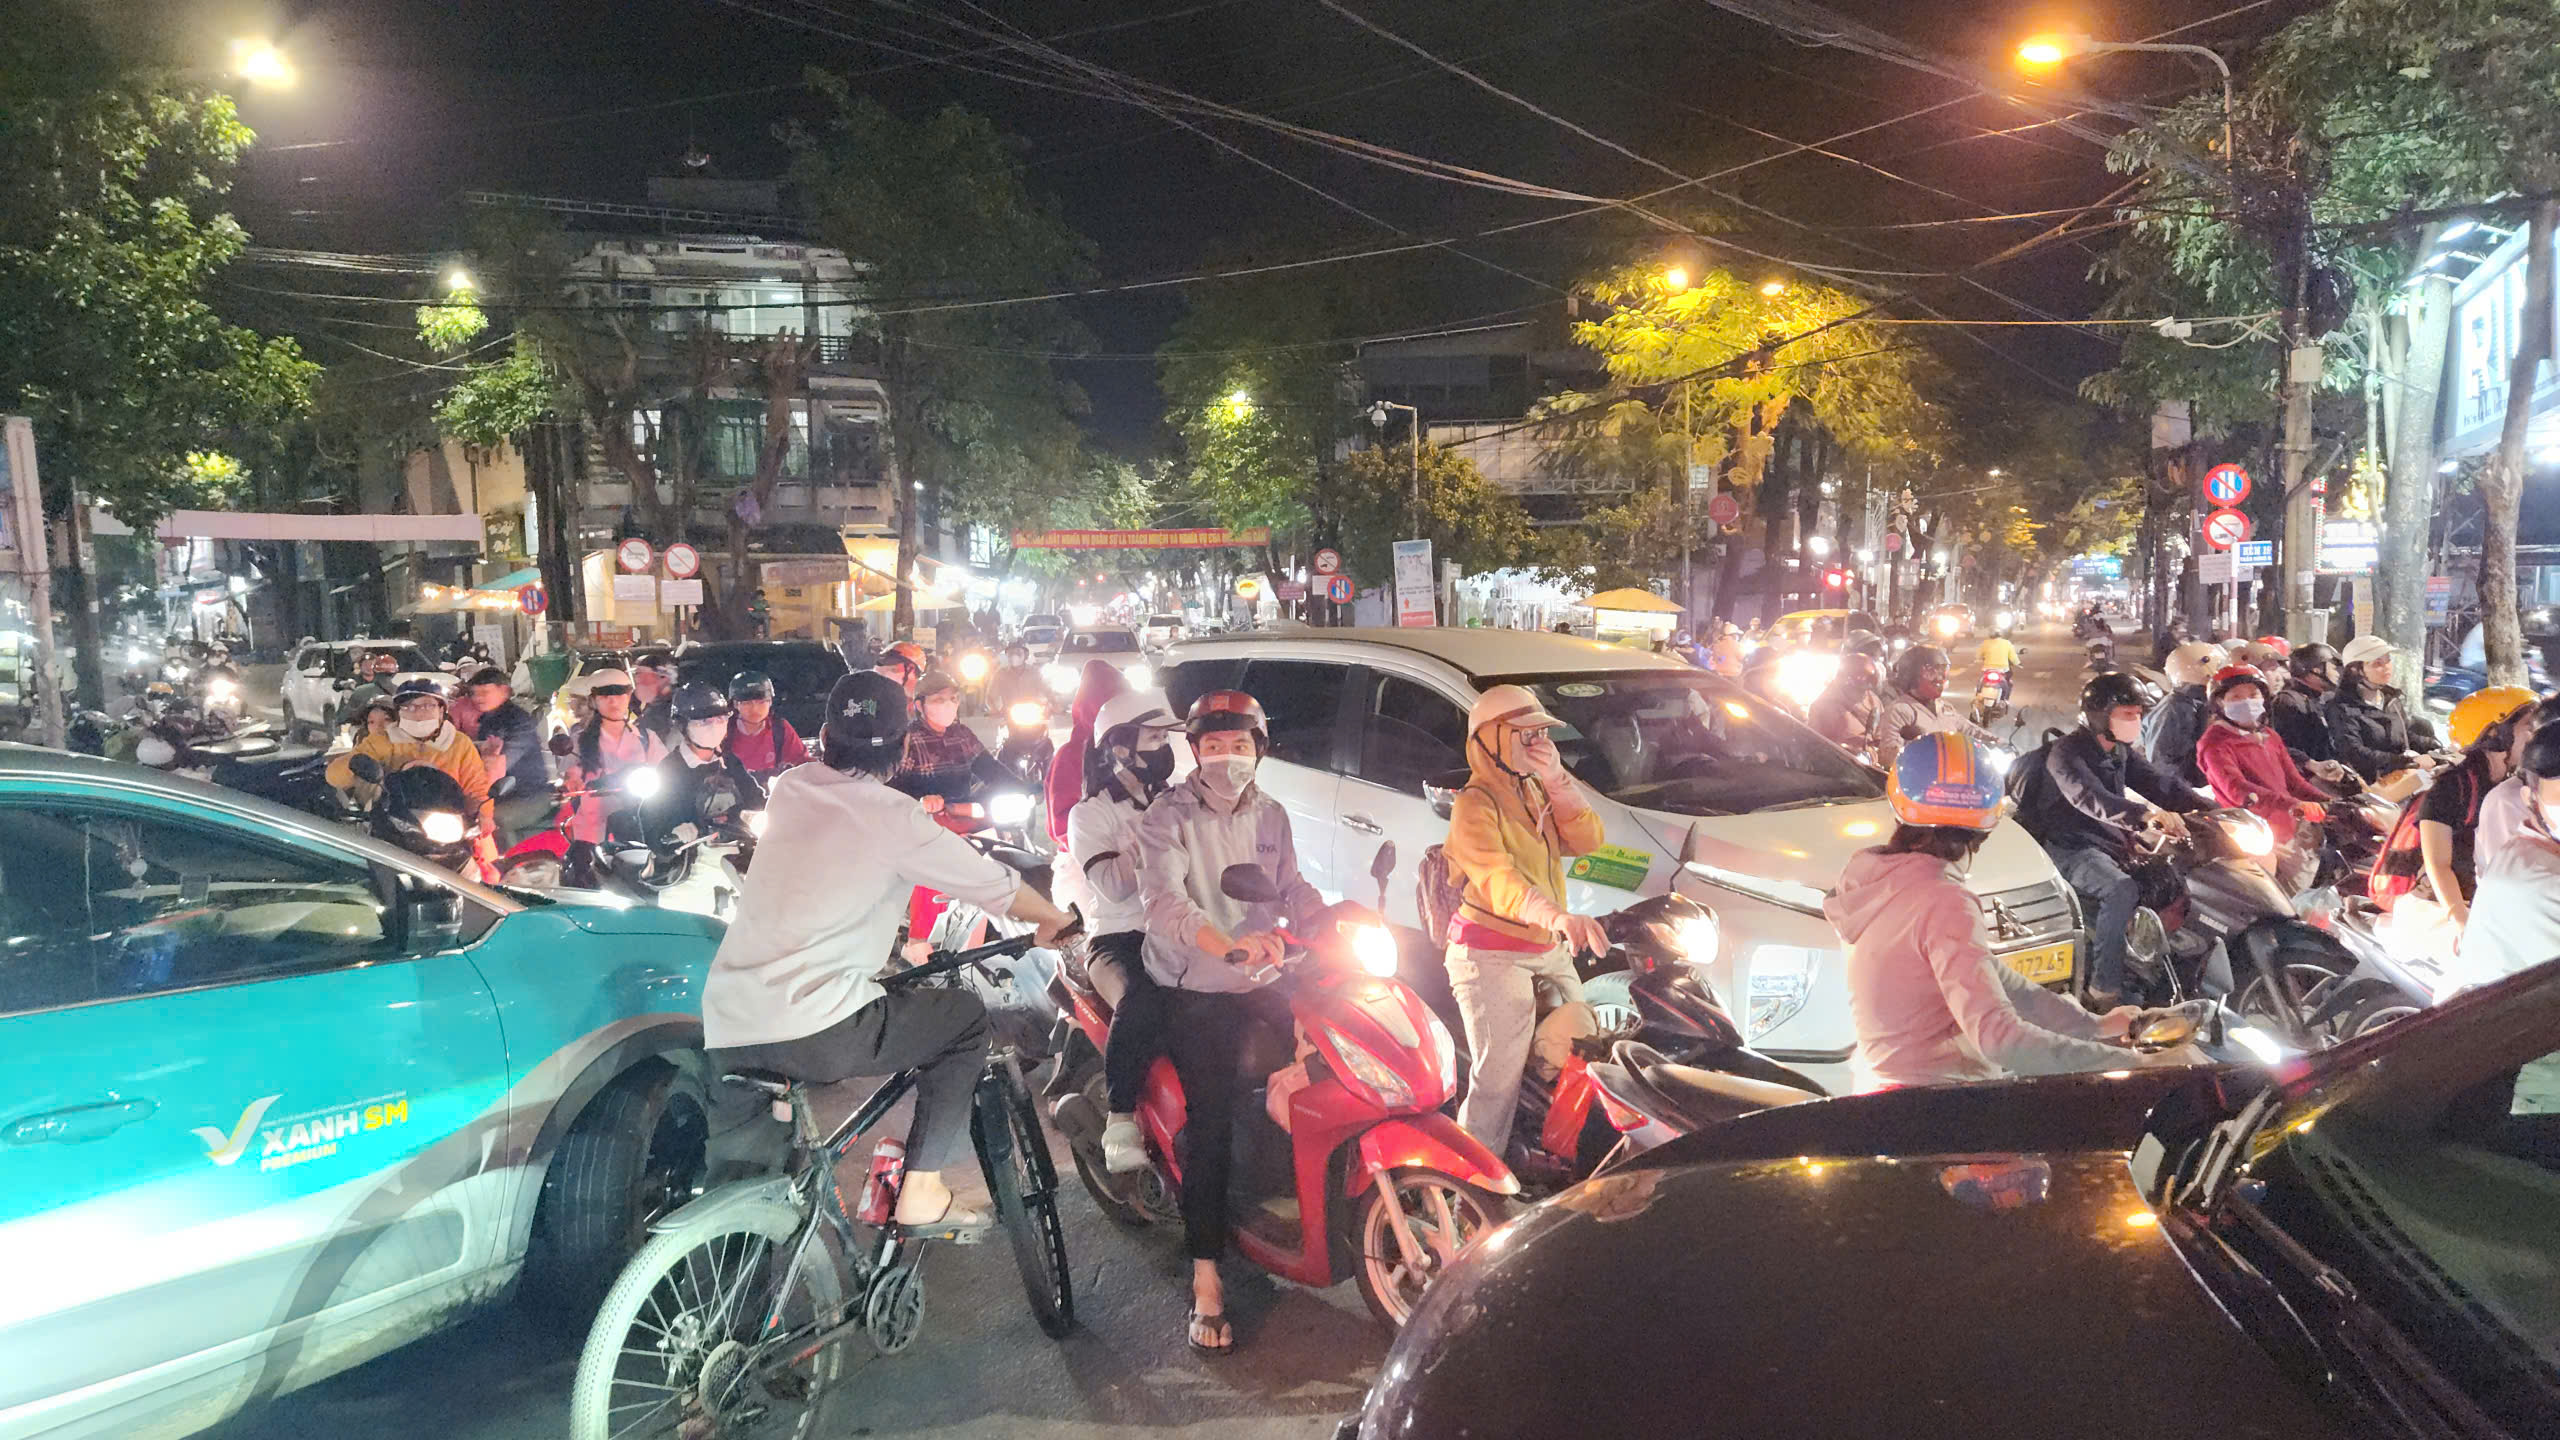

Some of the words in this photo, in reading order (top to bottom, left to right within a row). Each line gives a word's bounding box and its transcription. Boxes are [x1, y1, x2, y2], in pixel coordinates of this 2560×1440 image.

[261, 1111, 359, 1157] XANH
[364, 1099, 409, 1130] SM
[260, 1142, 337, 1173] PREMIUM
